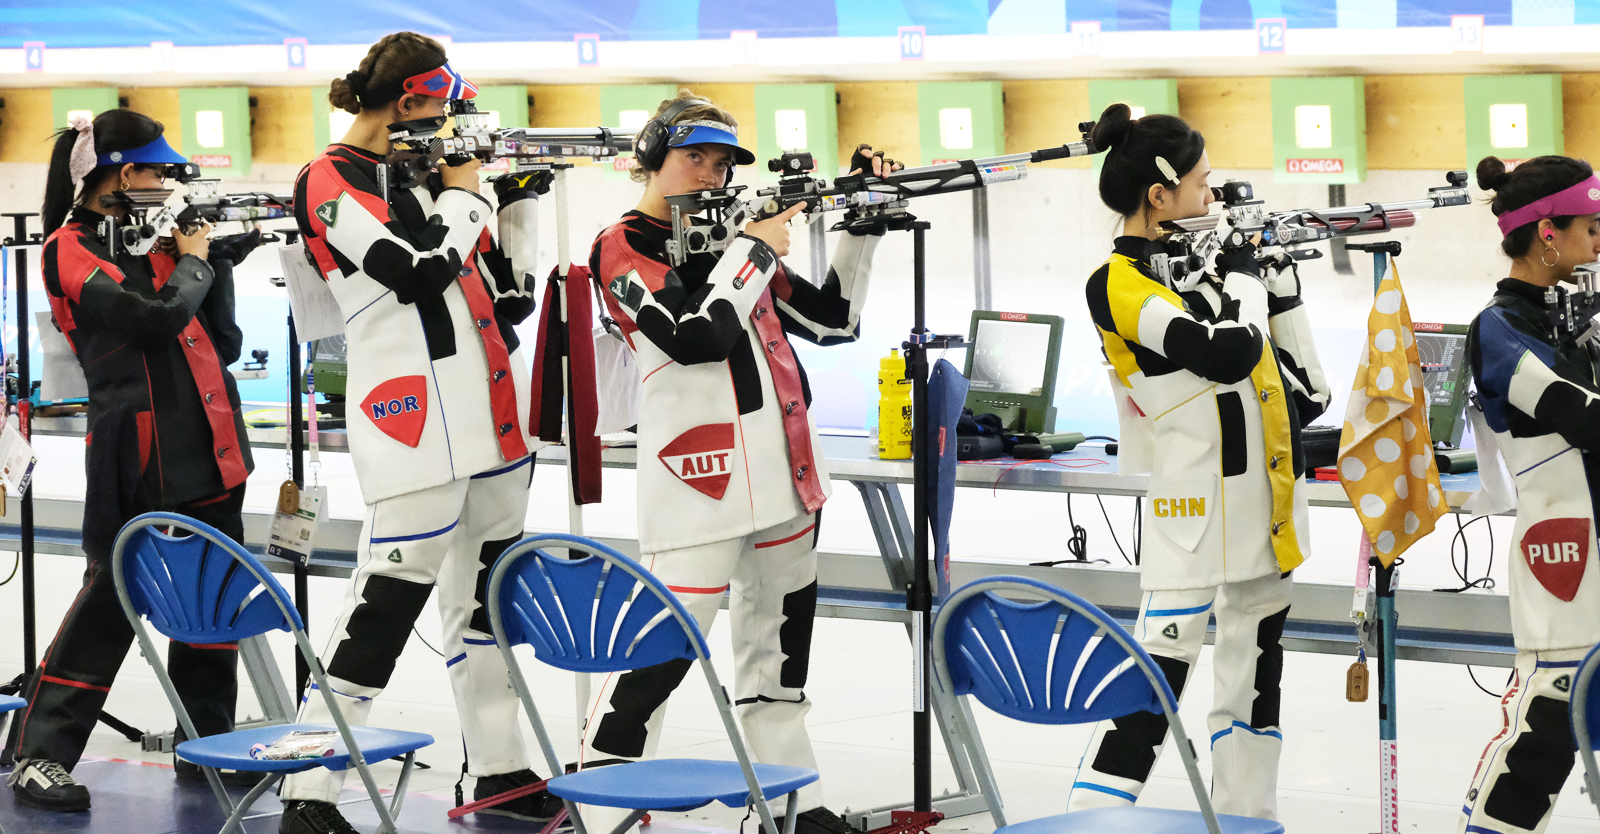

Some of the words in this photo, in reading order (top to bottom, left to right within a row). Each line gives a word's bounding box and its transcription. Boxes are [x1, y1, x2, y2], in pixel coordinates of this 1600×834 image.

[902, 34, 922, 54] 10
[1078, 31, 1093, 47] 11
[1260, 26, 1283, 47] 12
[1457, 25, 1478, 43] 13
[29, 48, 40, 67] 4
[291, 45, 303, 65] 6
[582, 41, 594, 61] 8
[1301, 159, 1343, 172] OMEGA
[371, 395, 421, 420] NOR
[682, 452, 729, 477] AUT
[1153, 497, 1206, 518] CHN
[1528, 541, 1580, 565] PUR
